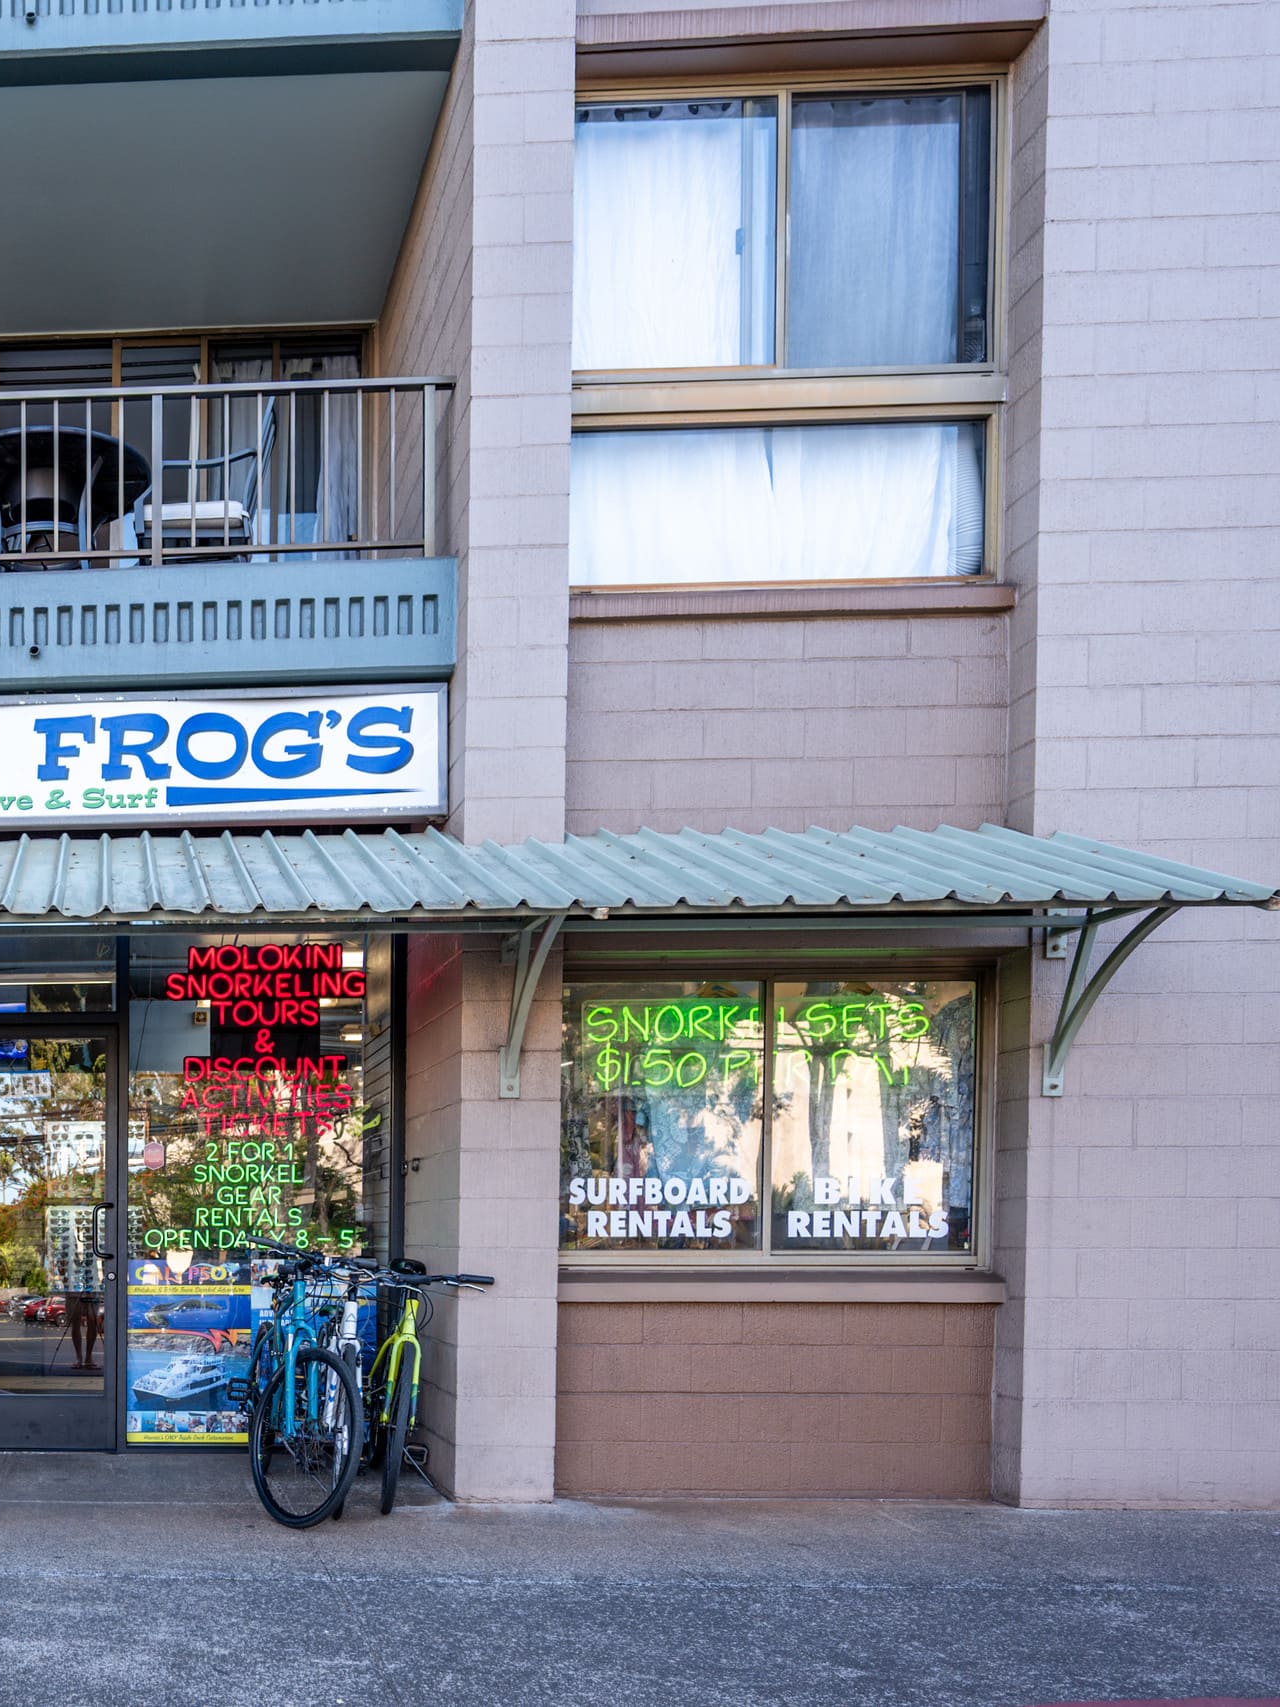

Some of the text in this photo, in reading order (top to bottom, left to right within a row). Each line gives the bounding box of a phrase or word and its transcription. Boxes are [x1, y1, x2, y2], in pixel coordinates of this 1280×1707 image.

[33, 706, 415, 781] FROG'S
[45, 789, 71, 810] &
[82, 787, 159, 809] Surf
[188, 944, 343, 971] MOLOKINI
[166, 971, 366, 999] SNORKELING
[211, 1001, 320, 1026] TOURS
[806, 1002, 930, 1040] SETS
[255, 1028, 275, 1053] &
[183, 1055, 346, 1082] DISCOUNT
[180, 1084, 353, 1110] ACTIVITIES
[198, 1111, 334, 1136] TICKETS
[206, 1142, 294, 1162] 2 FOR 1
[194, 1164, 304, 1184] SNORKEL
[217, 1186, 281, 1205] GEAR
[569, 1178, 751, 1205] SURFBOARD
[814, 1178, 924, 1205] BIKE
[195, 1207, 303, 1227] RENTALS
[587, 1211, 732, 1238] RENTALS
[787, 1211, 949, 1238] RENTALS
[144, 1229, 209, 1248] OPEN
[295, 1229, 309, 1249] 8
[339, 1229, 354, 1248] 5
[135, 1265, 228, 1283] CLPSO
